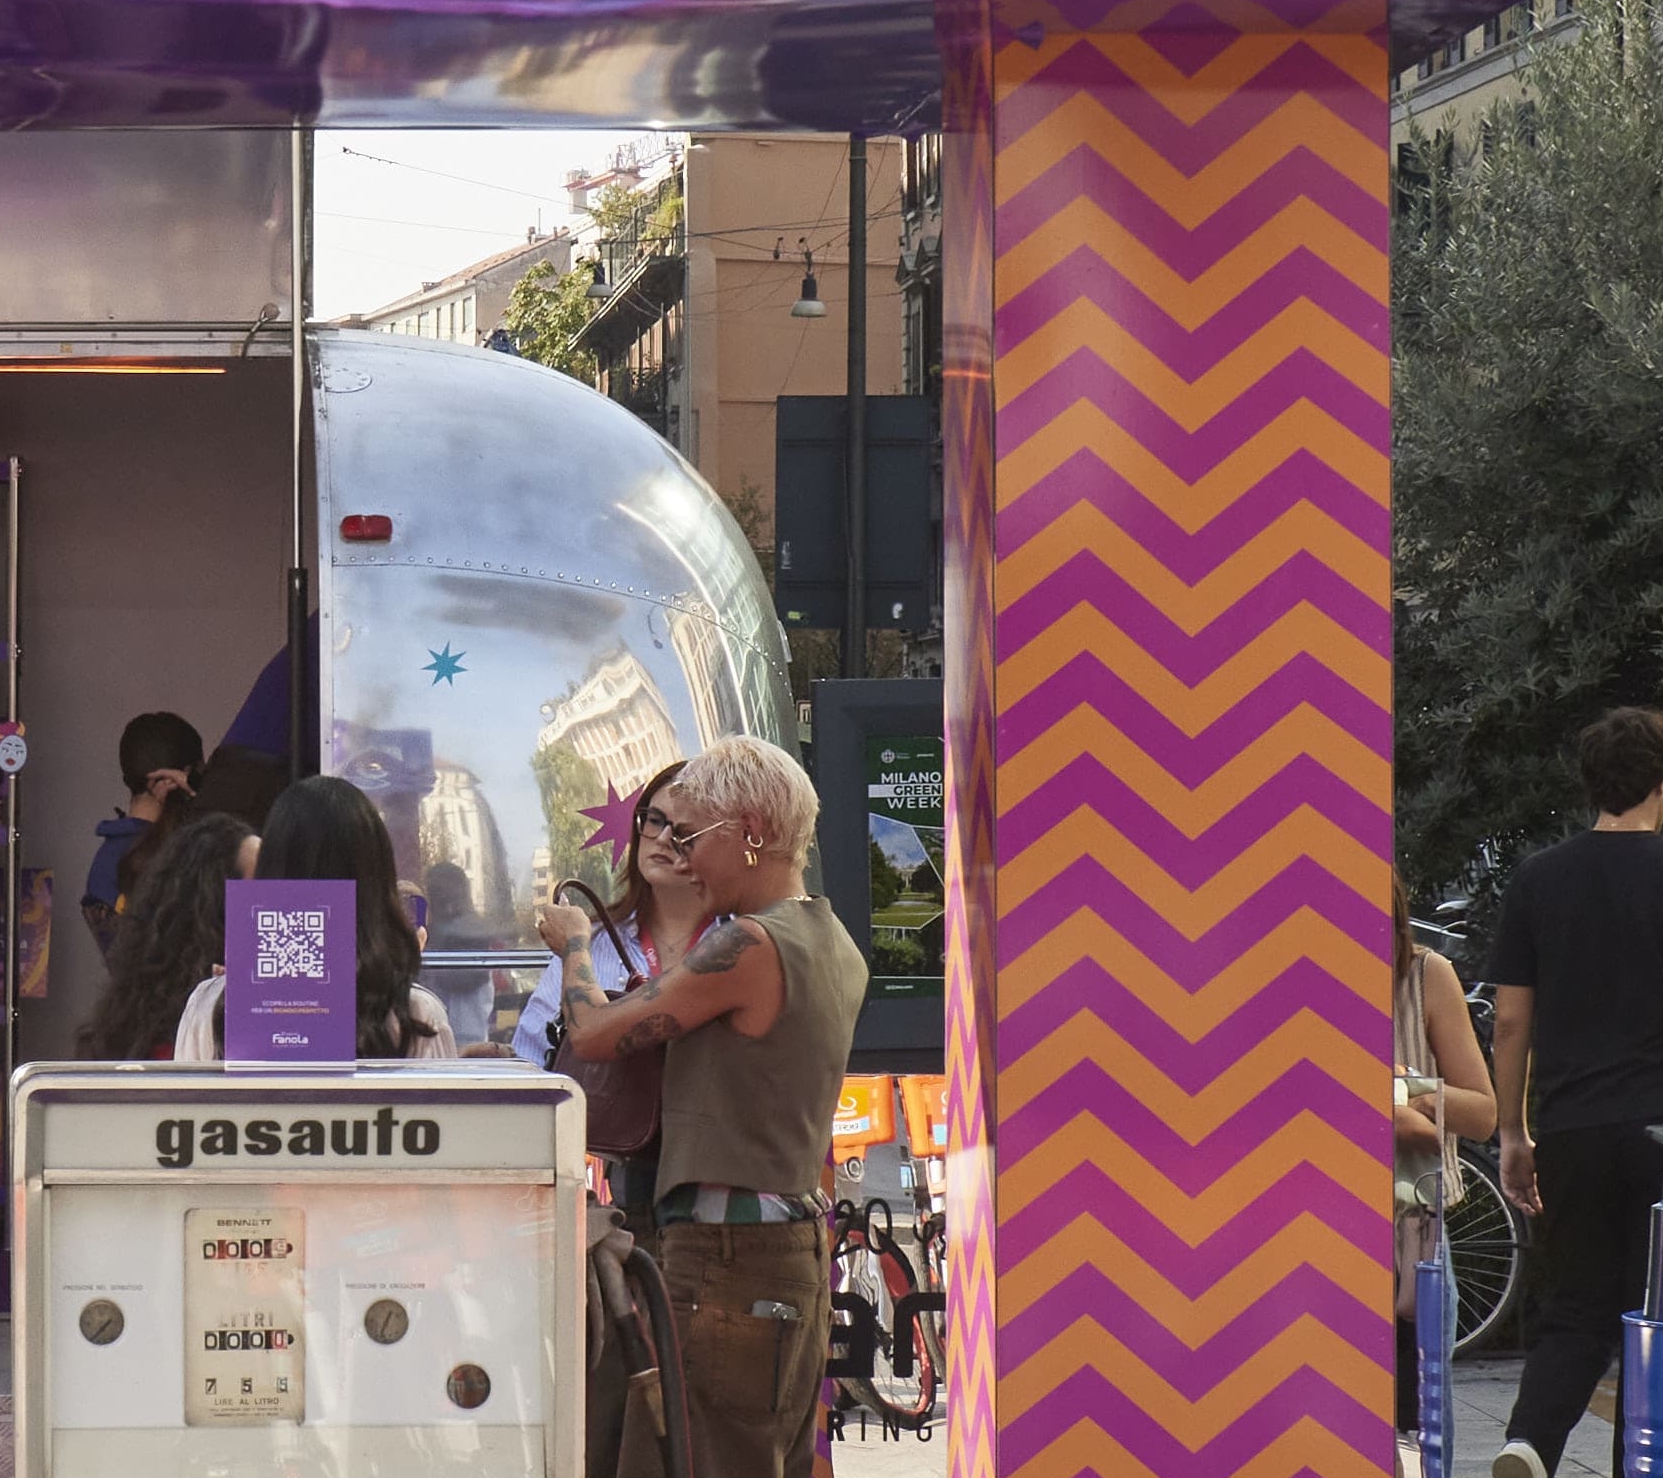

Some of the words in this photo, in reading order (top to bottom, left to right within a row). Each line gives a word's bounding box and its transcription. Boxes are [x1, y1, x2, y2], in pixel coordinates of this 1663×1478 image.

[880, 771, 943, 784] MILANO
[893, 784, 942, 796] GREEN
[887, 797, 942, 810] WEEK
[154, 1107, 442, 1169] gasauto
